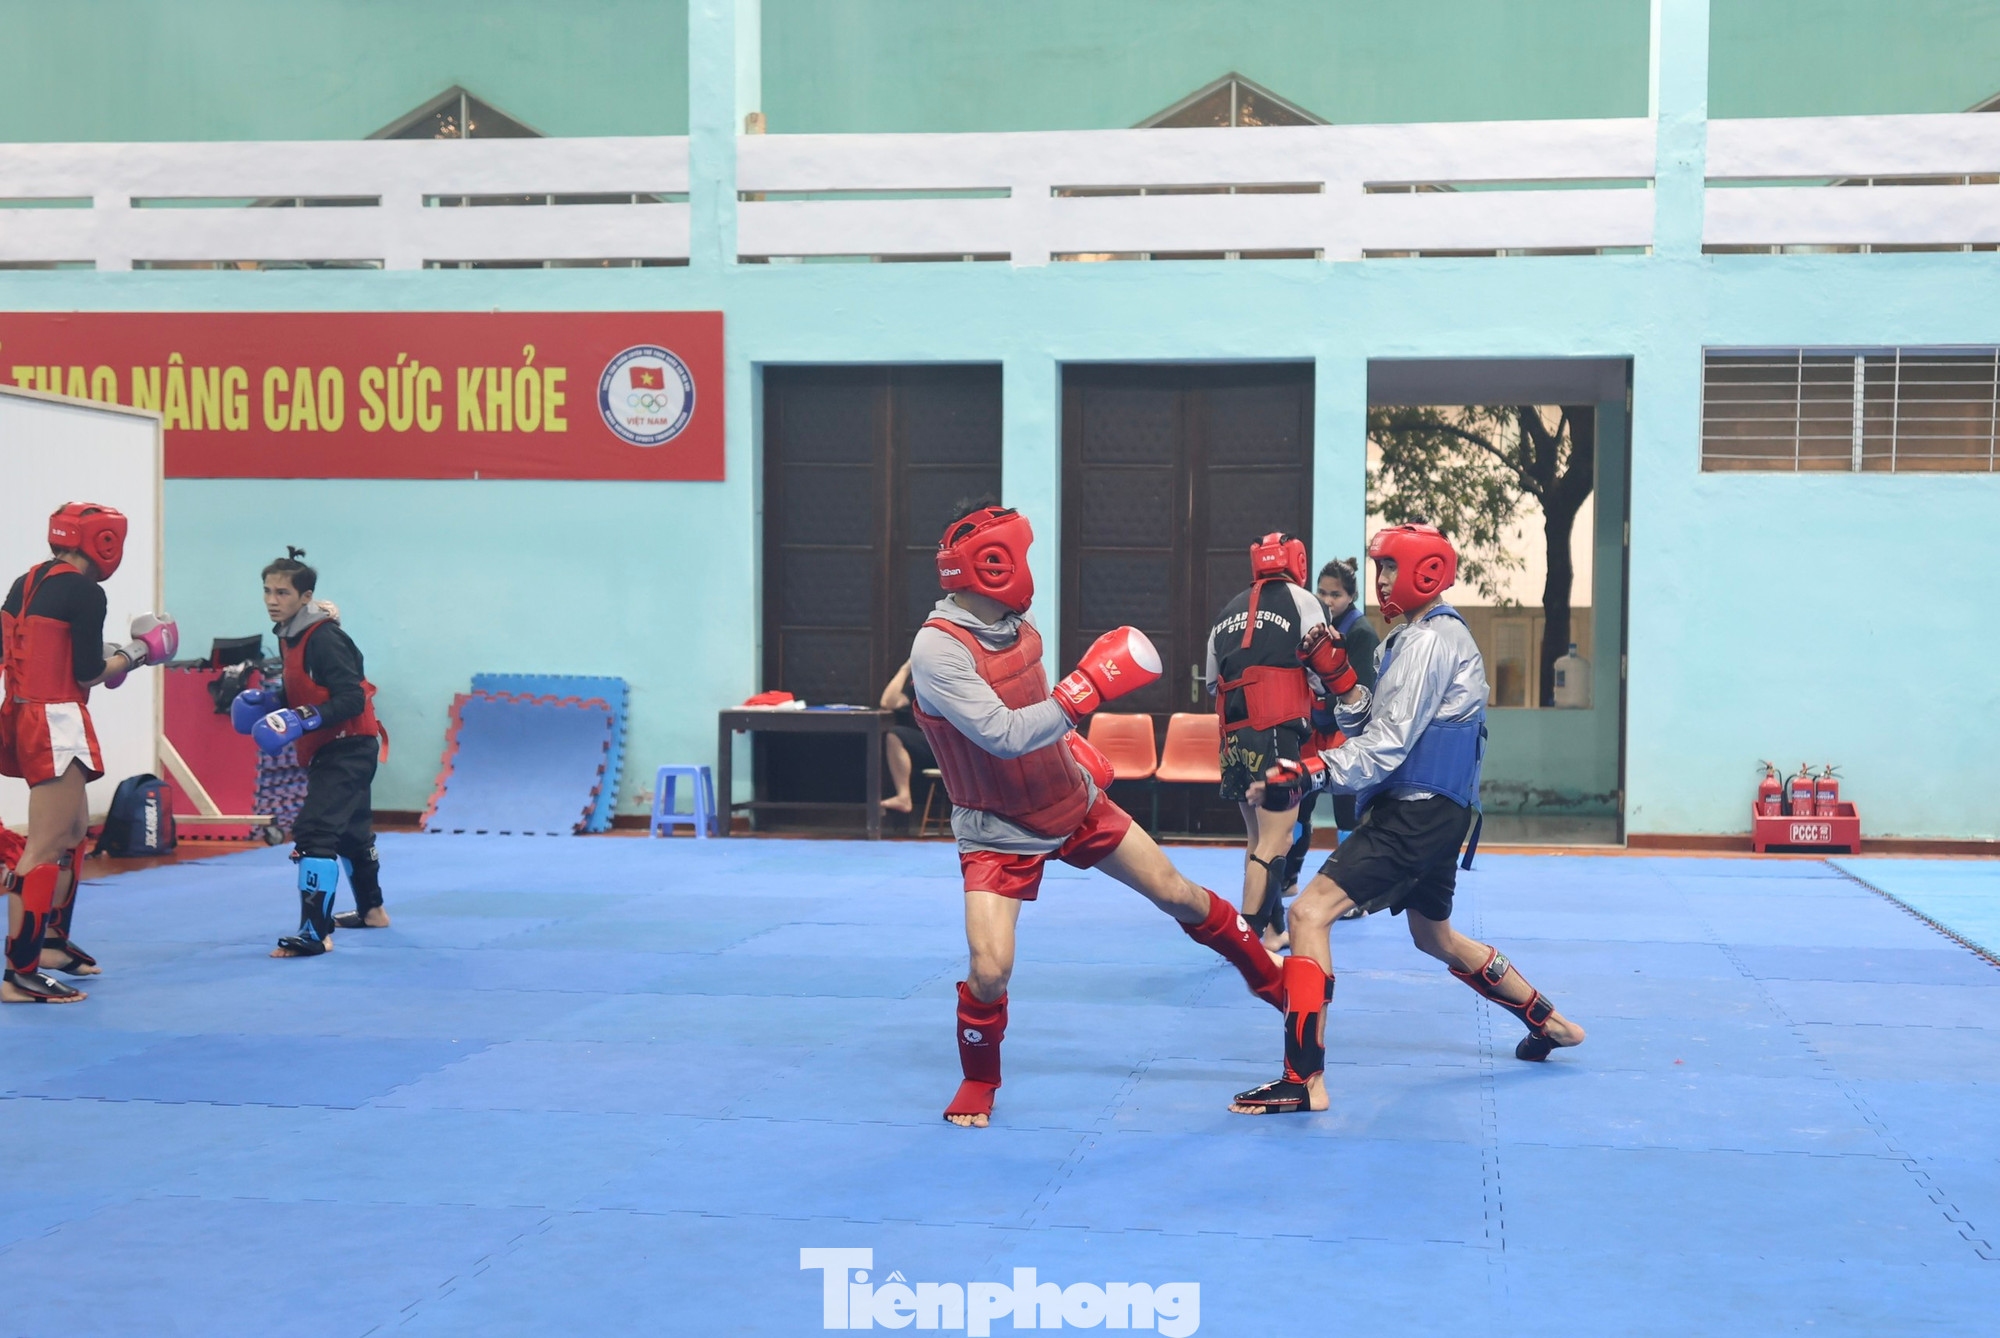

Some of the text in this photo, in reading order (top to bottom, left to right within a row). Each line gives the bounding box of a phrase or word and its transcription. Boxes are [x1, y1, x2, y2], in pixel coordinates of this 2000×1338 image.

[131, 352, 249, 432] NÂNG
[262, 366, 345, 432] CAO
[359, 352, 443, 433] SỨC
[457, 343, 568, 433] KHỎE
[647, 417, 668, 425] NAM
[1228, 620, 1264, 634] STUO
[1255, 610, 1291, 633] ESIGN
[1792, 824, 1818, 841] PCCC
